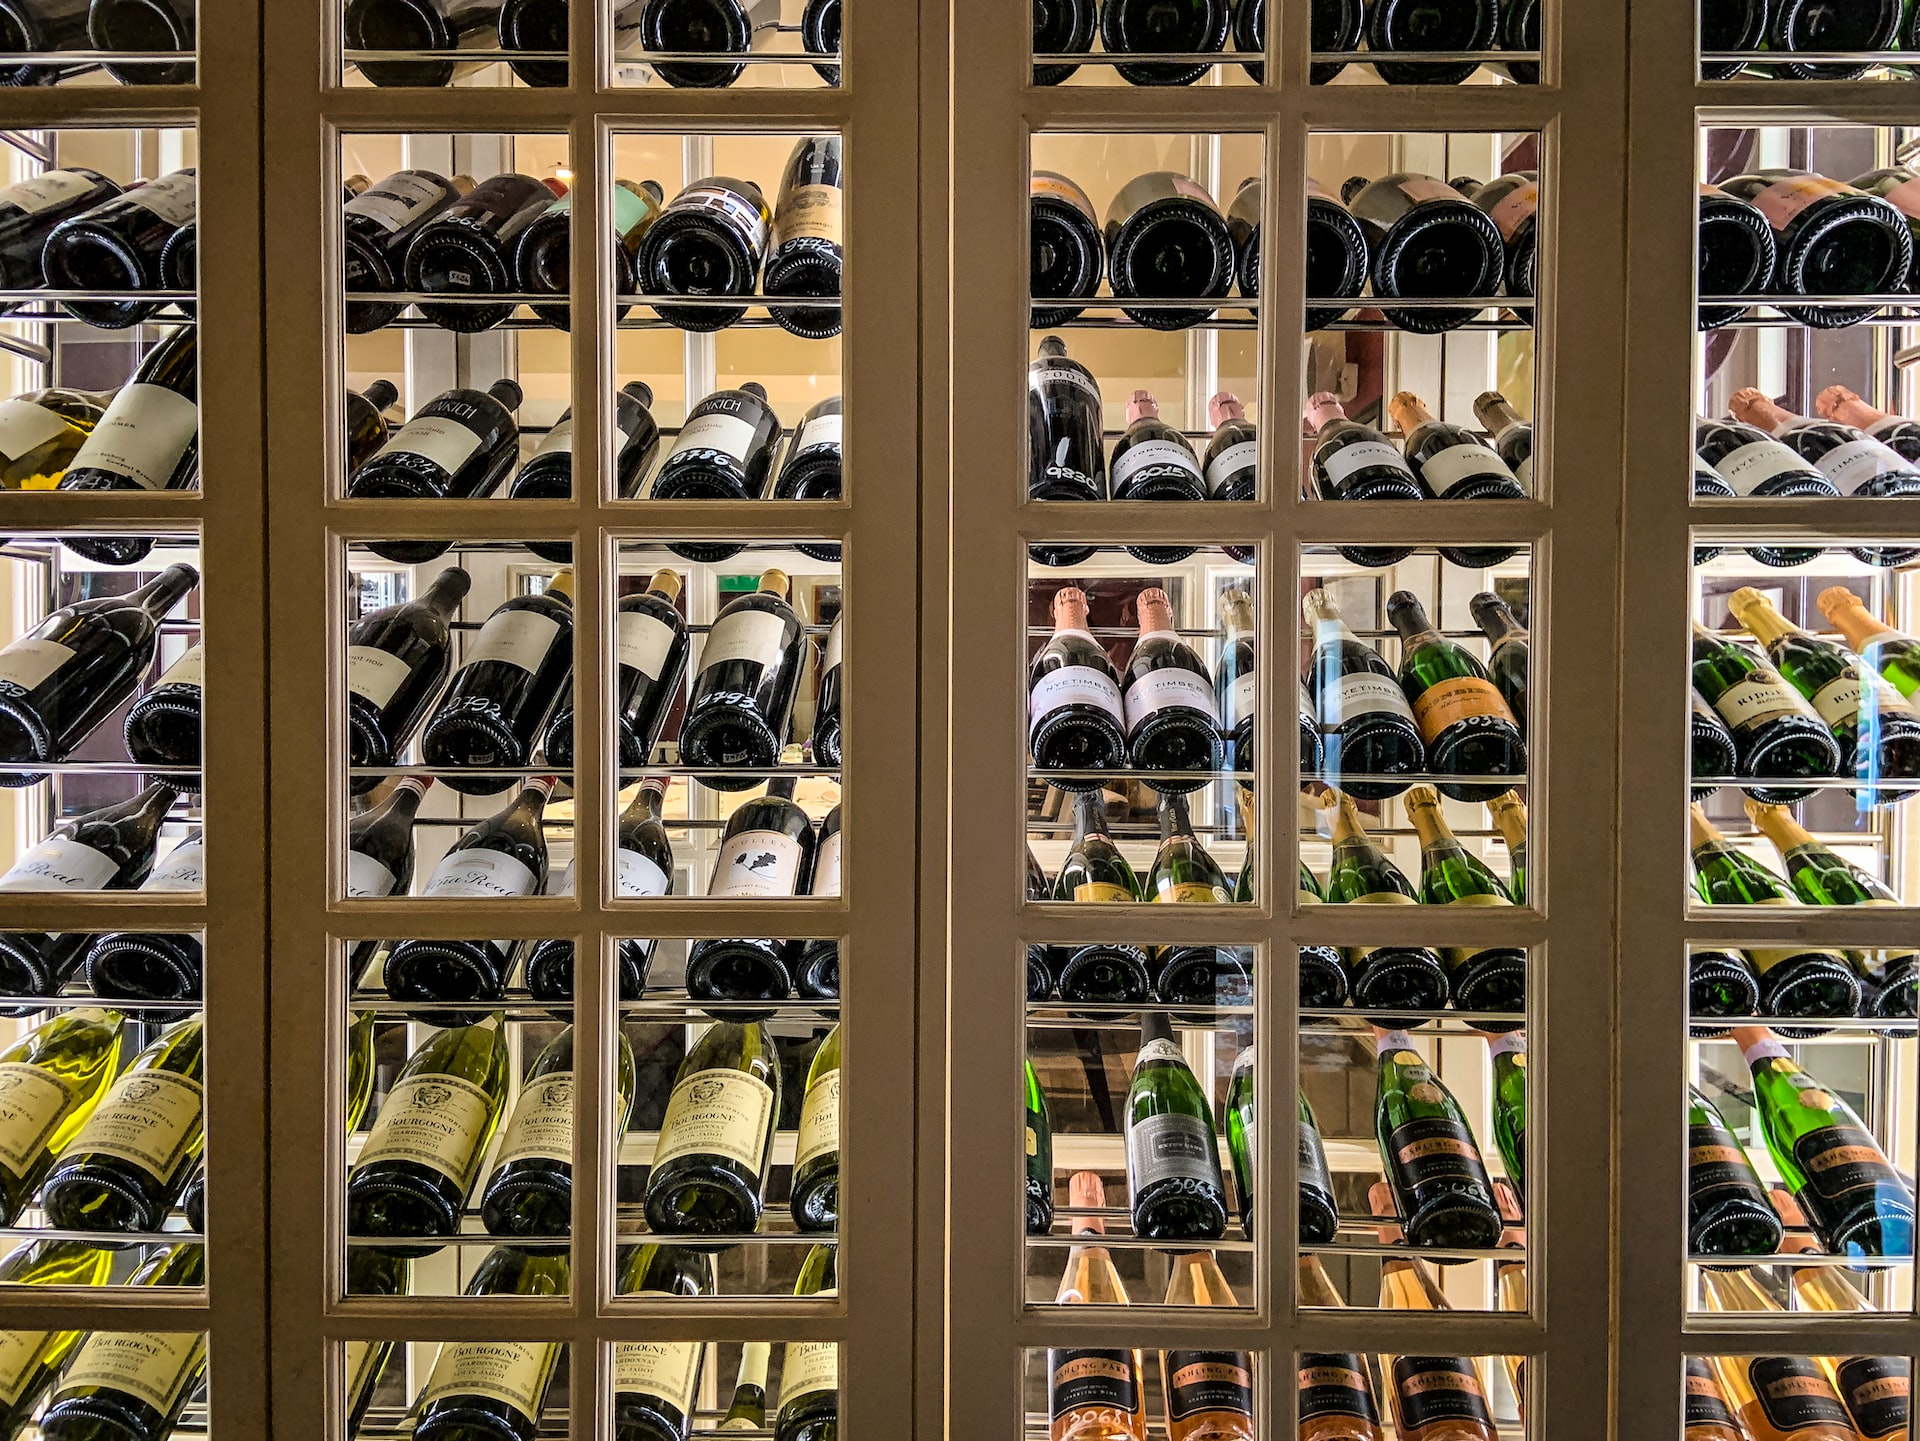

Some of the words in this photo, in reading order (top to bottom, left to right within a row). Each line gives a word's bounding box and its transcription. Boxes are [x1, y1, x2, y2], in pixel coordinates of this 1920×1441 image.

[672, 449, 731, 466] 9786
[1046, 466, 1098, 491] 9830
[1046, 678, 1116, 698] NYETIMBER
[697, 691, 759, 710] 9793
[731, 838, 787, 849] CULLEN
[387, 1117, 456, 1136] BOURGOGNE
[670, 1112, 736, 1131] BOURGOGNE
[92, 1337, 161, 1358] BOURGOGNE
[452, 1345, 522, 1363] BOURGOGNE
[1176, 1366, 1223, 1383] ASHLING
[1069, 1410, 1122, 1425] 3068
